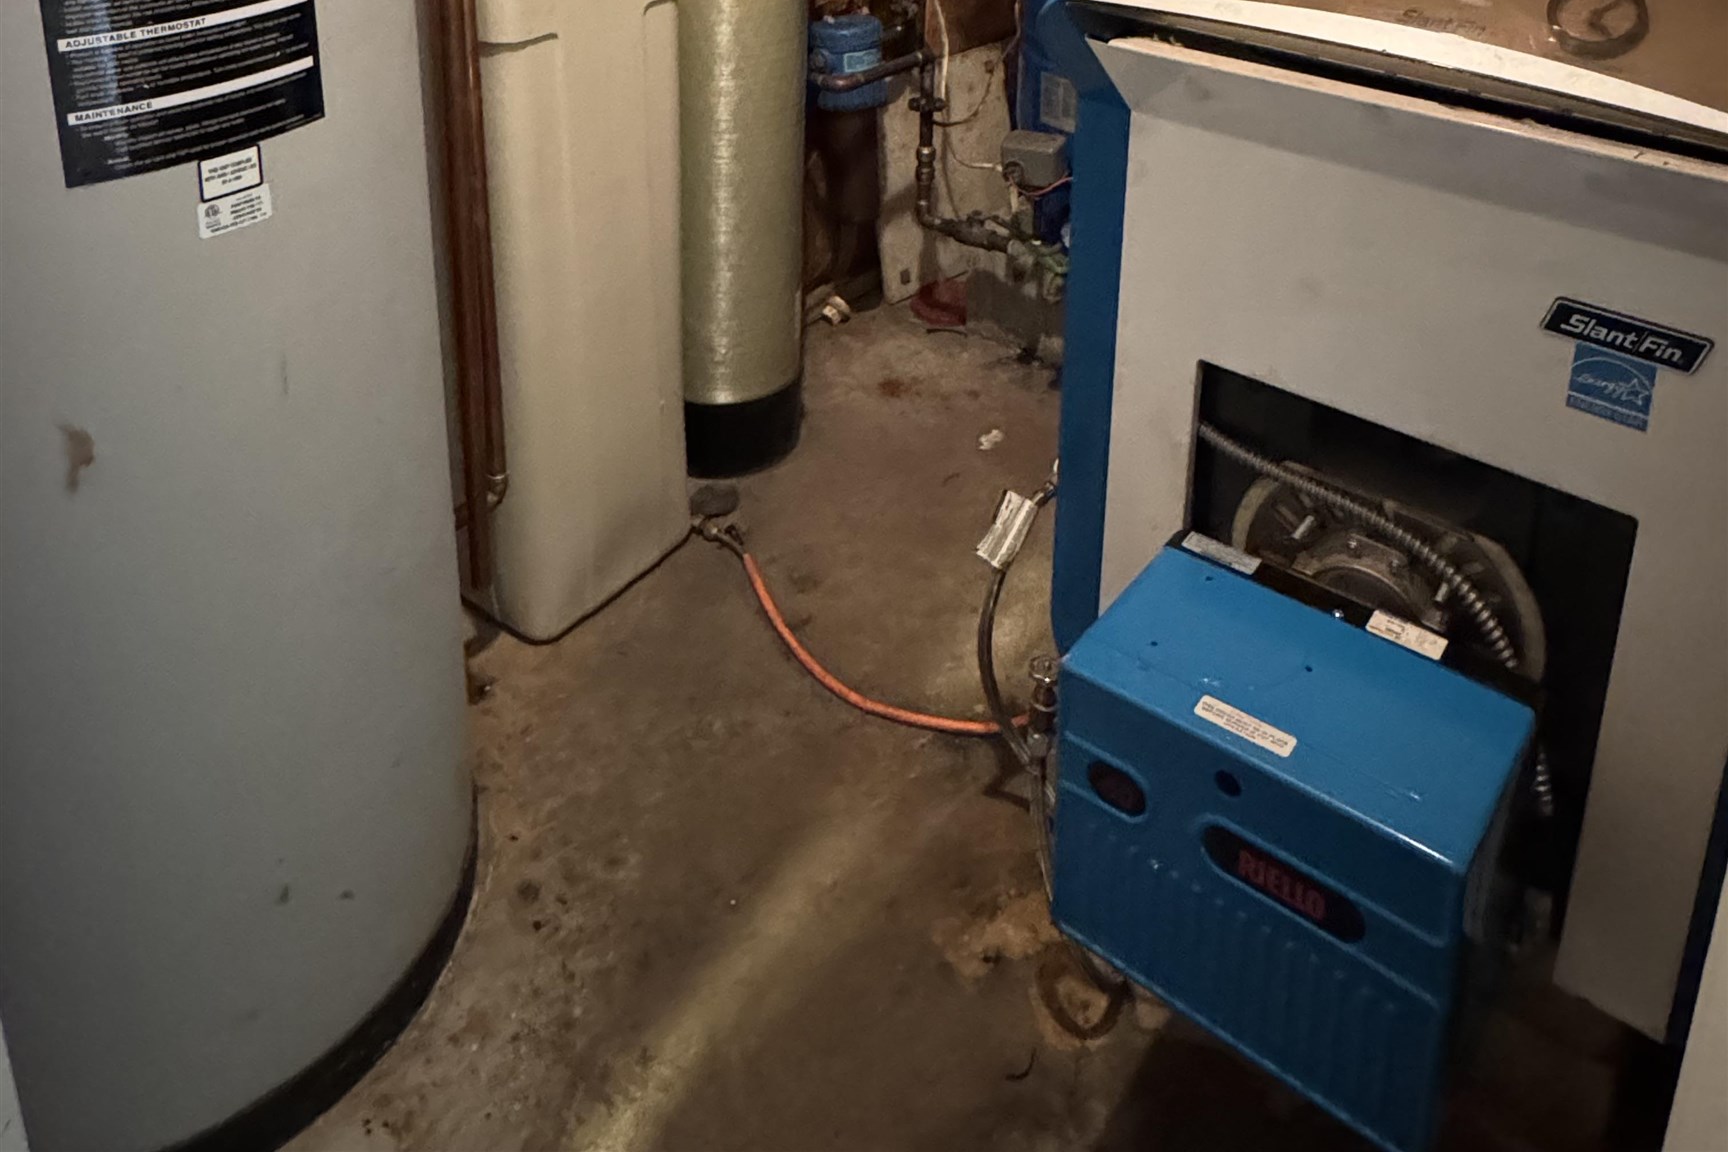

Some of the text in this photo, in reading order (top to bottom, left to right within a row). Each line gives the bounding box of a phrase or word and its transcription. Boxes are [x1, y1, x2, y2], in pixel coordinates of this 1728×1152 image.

[65, 31, 137, 48] ADJUSTABLE
[140, 17, 207, 37] THERMOSTAT
[74, 101, 153, 122] MAINTENANCE
[1238, 849, 1326, 921] RIELLO
